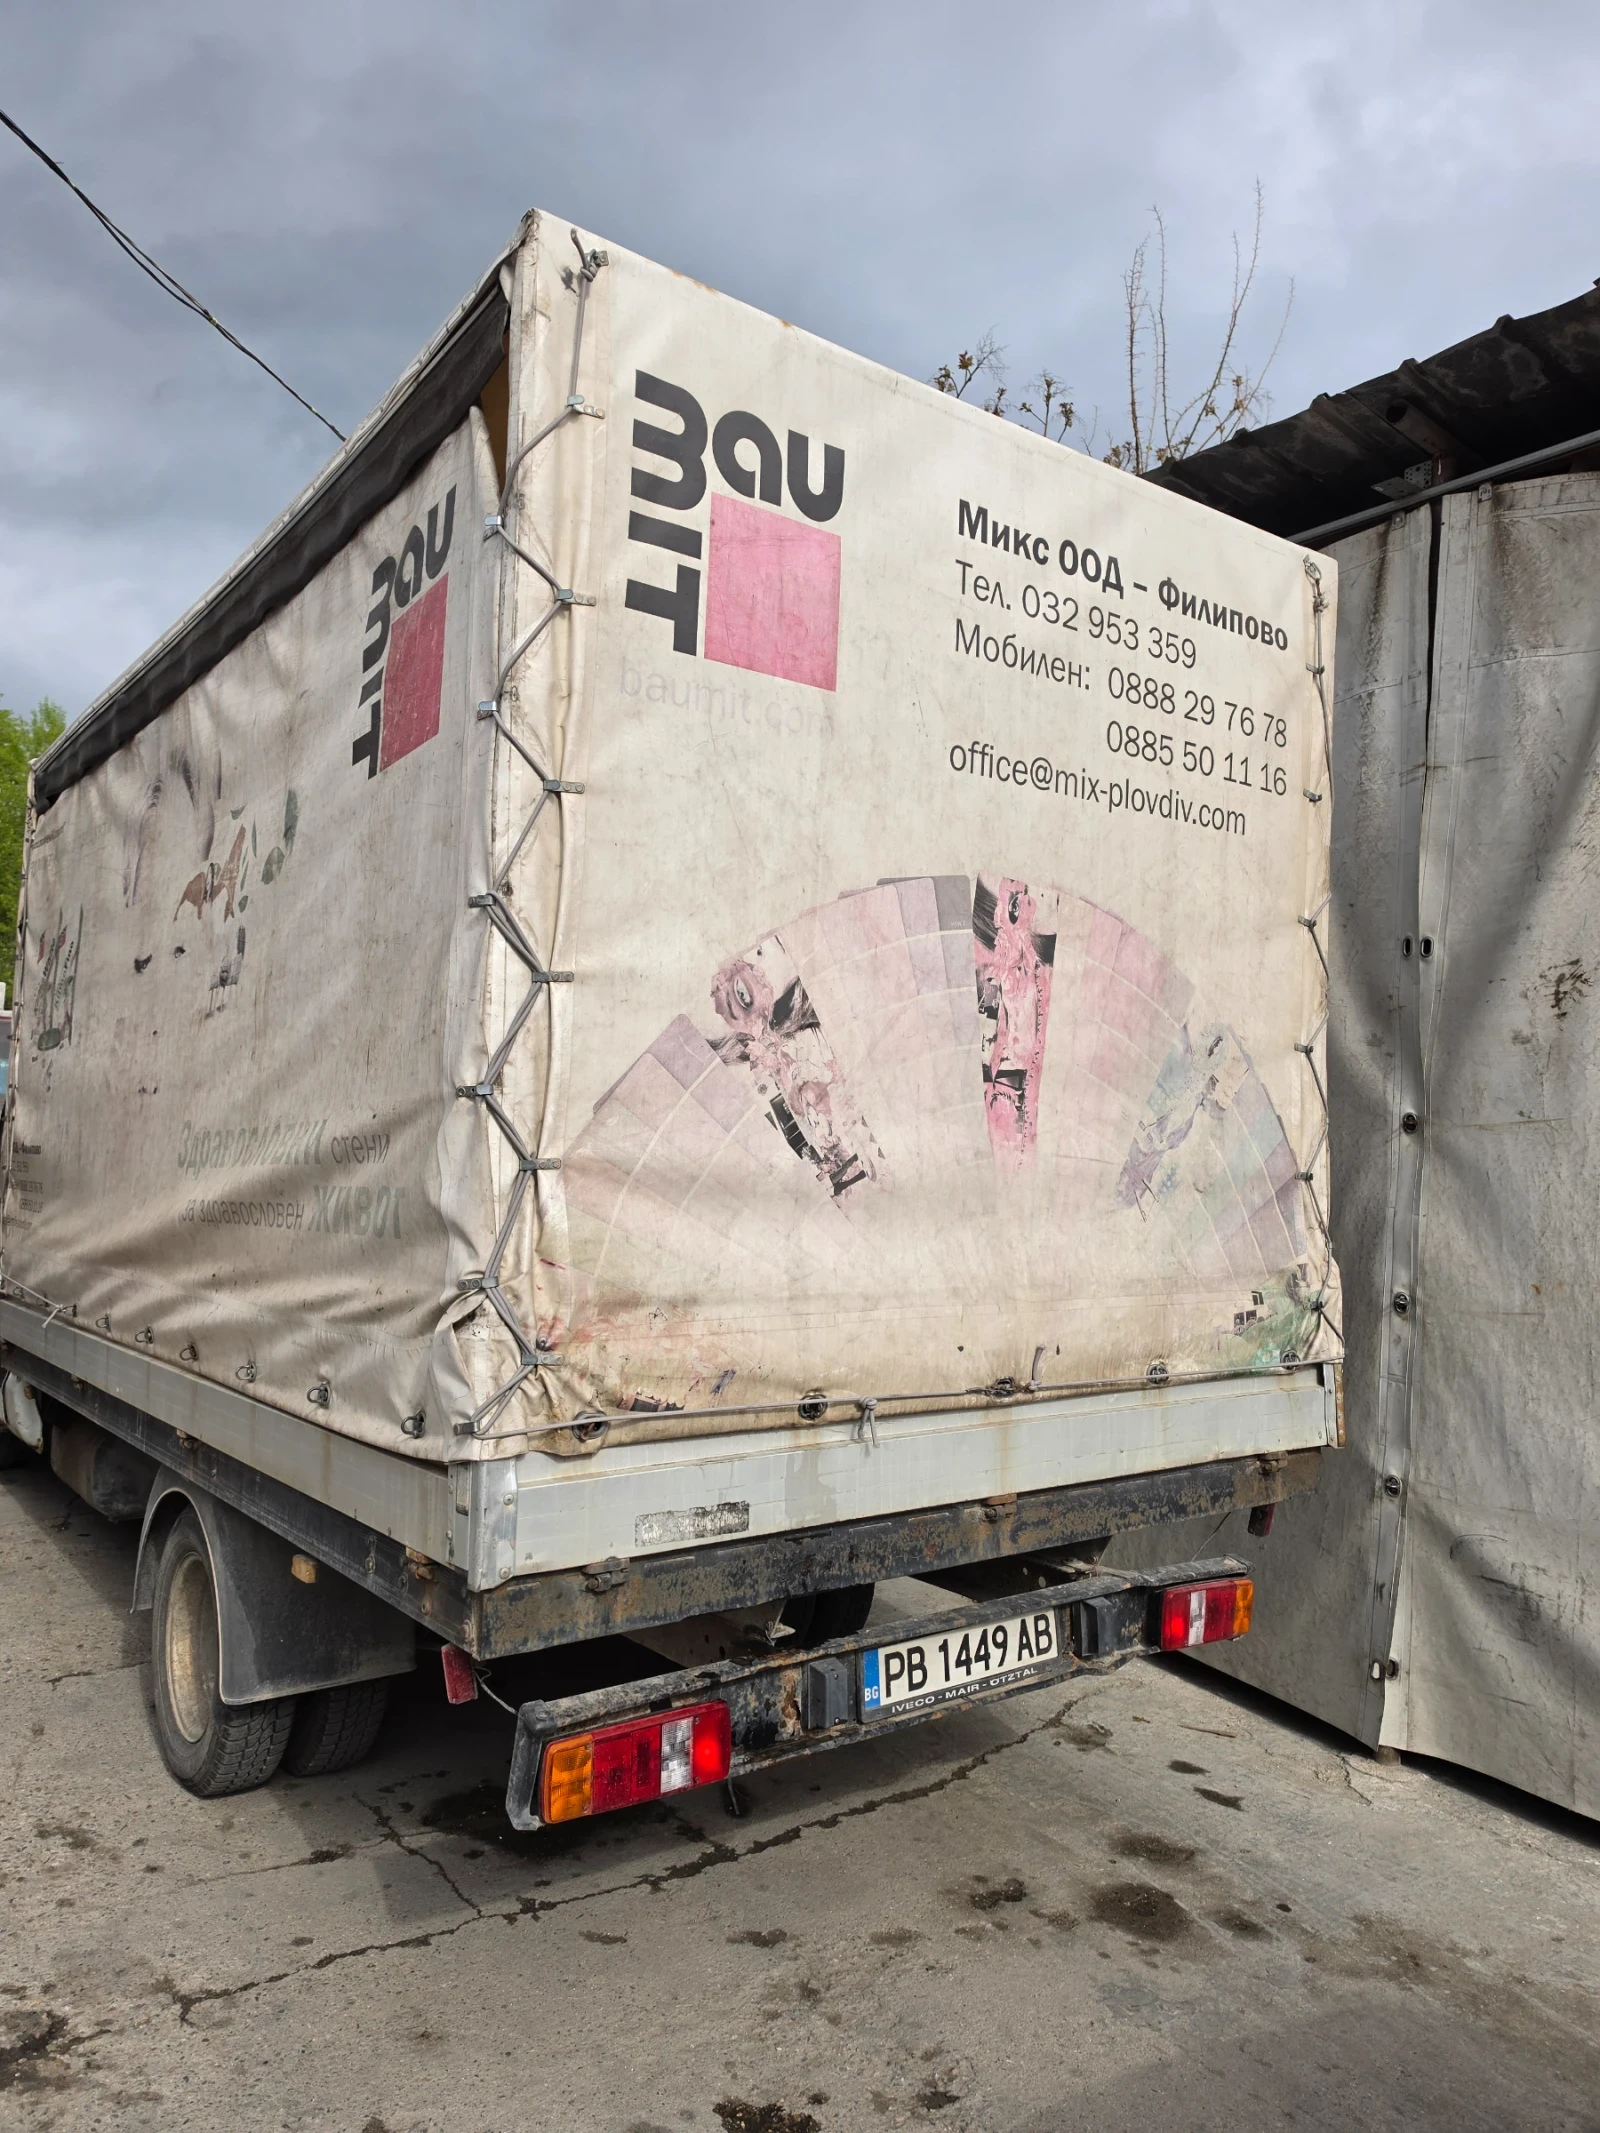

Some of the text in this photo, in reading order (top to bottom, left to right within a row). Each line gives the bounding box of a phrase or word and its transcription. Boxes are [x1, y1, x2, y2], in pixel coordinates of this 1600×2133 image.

[955, 558, 1196, 669] Тел. 032 953 359
[958, 498, 1050, 566] Микс
[1059, 539, 1124, 600] ООД
[1158, 576, 1288, 651] Филипово
[955, 618, 1287, 748] Мобилен: 0888 29 76 78
[950, 741, 1245, 835] office@mix-plovdiv.com
[1107, 720, 1287, 796] 0885 50 11 16
[330, 1132, 391, 1164] стени
[199, 1199, 305, 1230] здравословен
[864, 1613, 1053, 1702] BG PB 1449 AB
[891, 1696, 935, 1714] IVECO
[945, 1683, 980, 1699] MAIR
